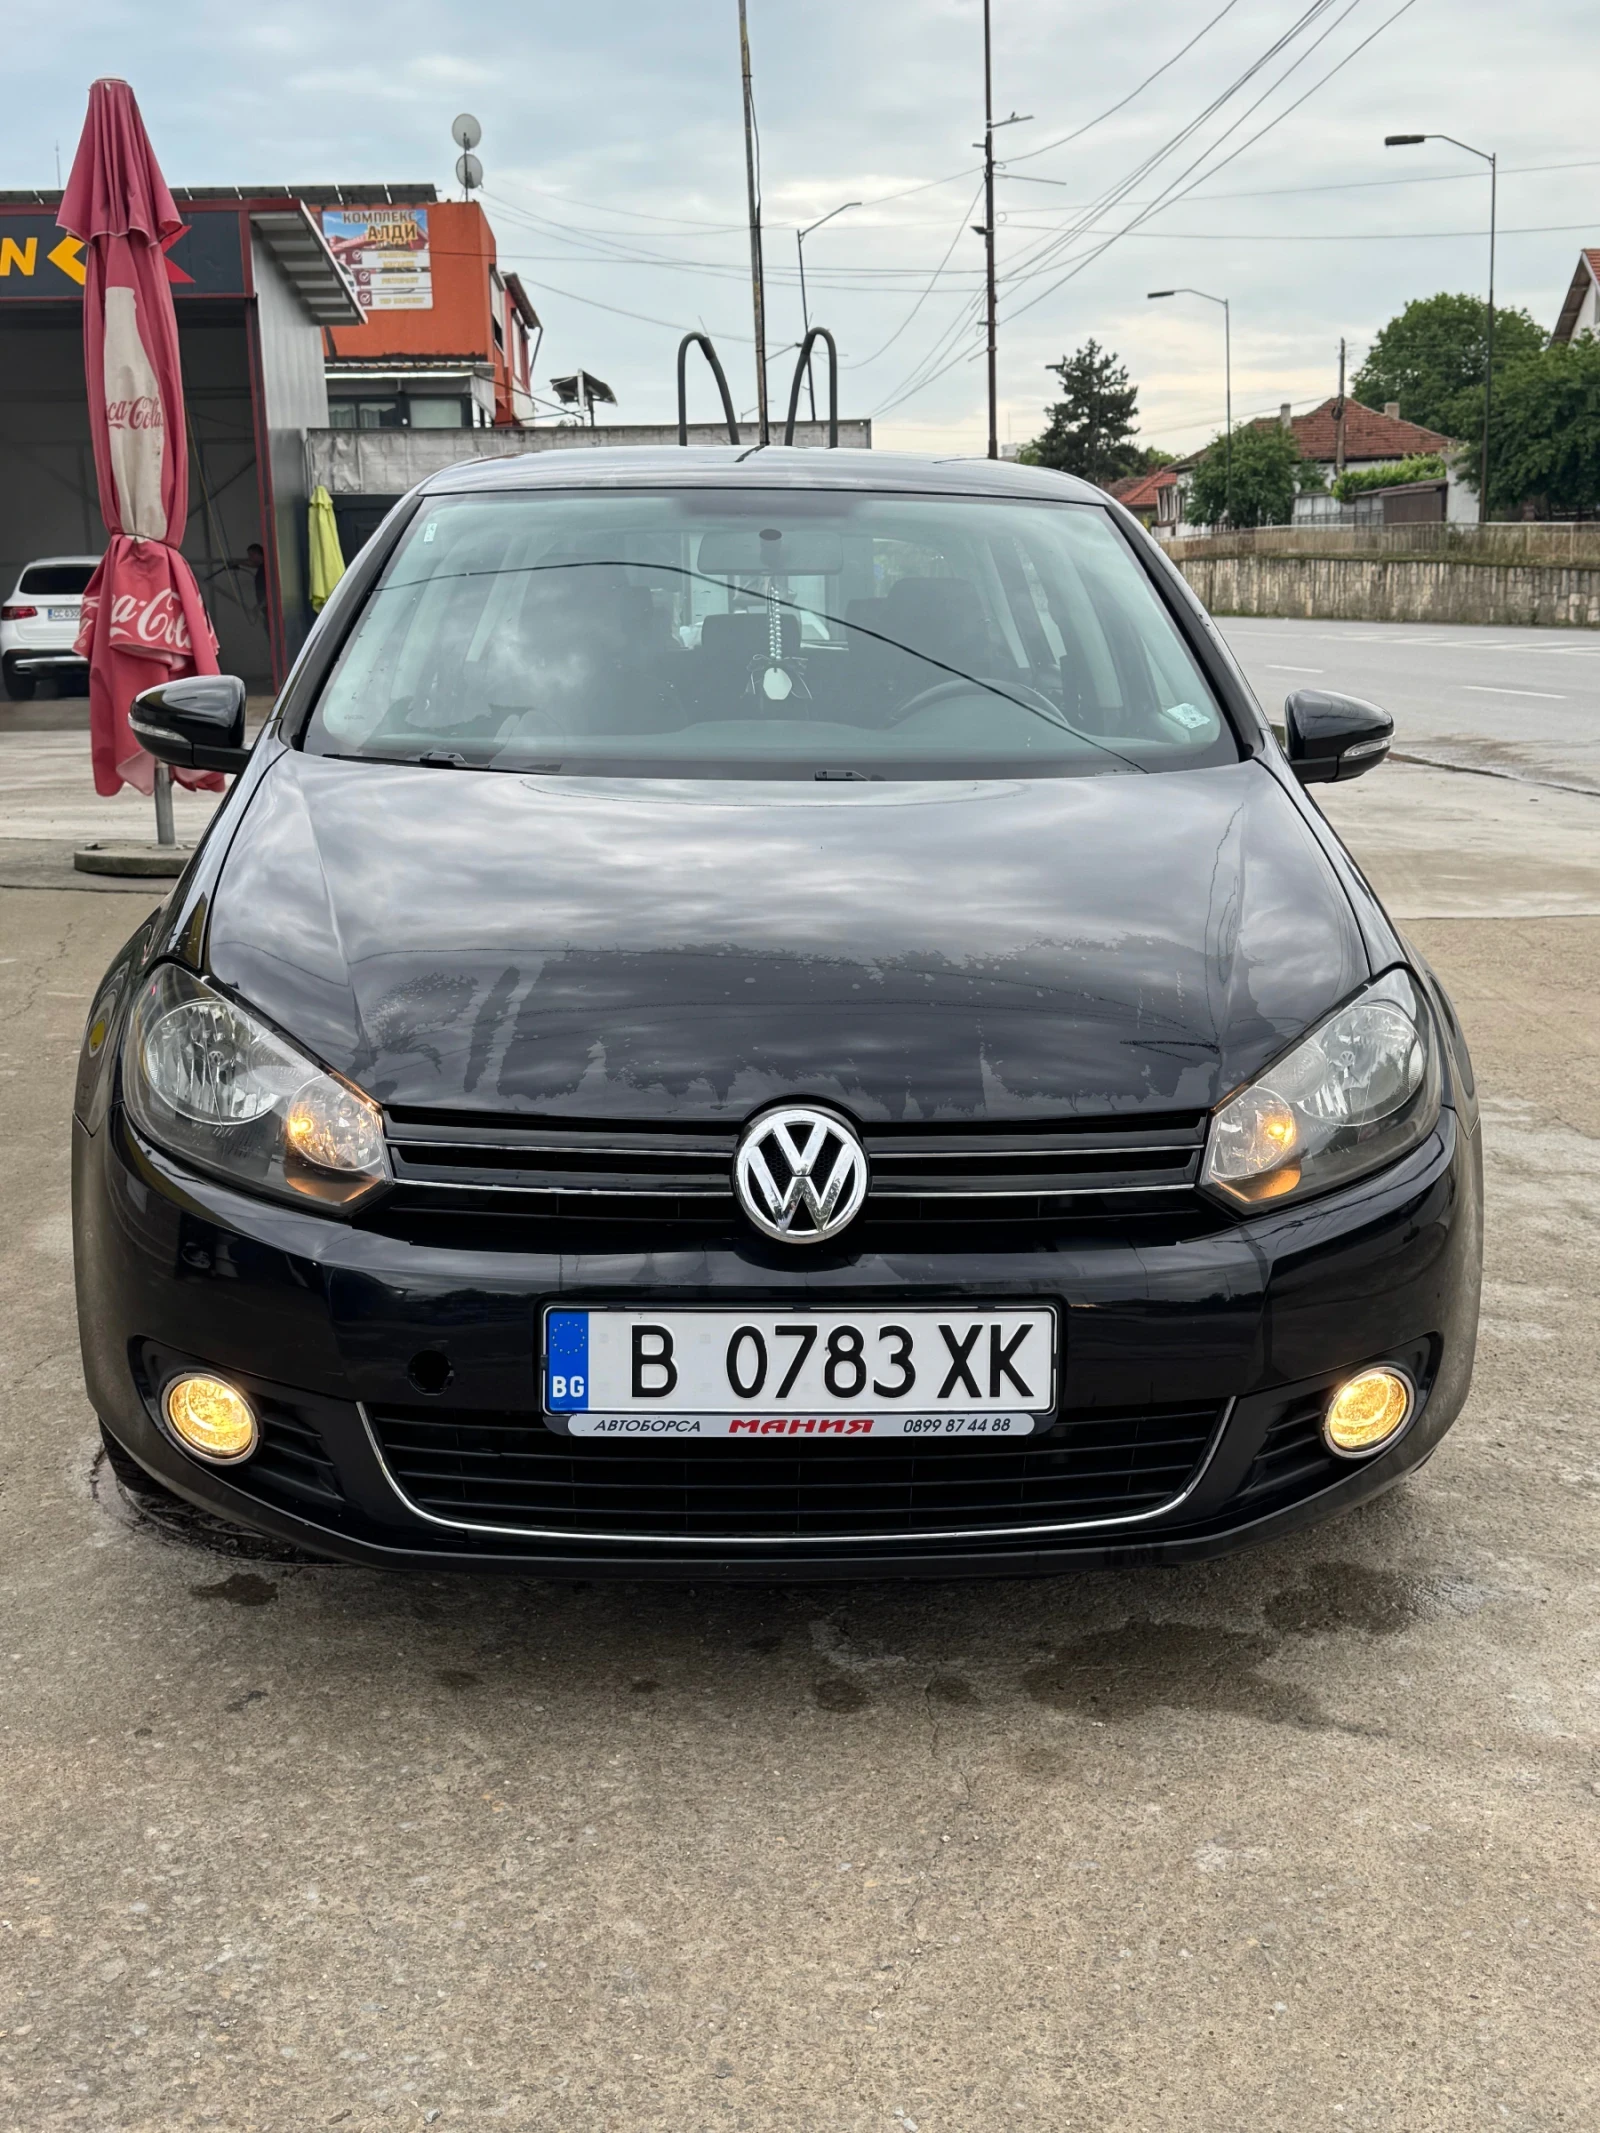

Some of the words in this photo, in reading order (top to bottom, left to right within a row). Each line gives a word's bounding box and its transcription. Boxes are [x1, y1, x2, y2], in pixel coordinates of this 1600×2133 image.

[343, 211, 416, 224] КОМПЛЕКС
[366, 223, 417, 243] АЛДИ
[107, 395, 163, 430] ca-Cola
[631, 1324, 678, 1398] B
[725, 1324, 917, 1399] 0783
[936, 1323, 1035, 1398] XK
[552, 1375, 585, 1398] BG
[593, 1419, 701, 1433] АВТОБОРСА
[728, 1419, 875, 1435] МАНИЯ
[903, 1419, 942, 1433] 0899
[945, 1418, 965, 1433] 87
[967, 1418, 987, 1432] 44
[991, 1418, 1011, 1432] 88
